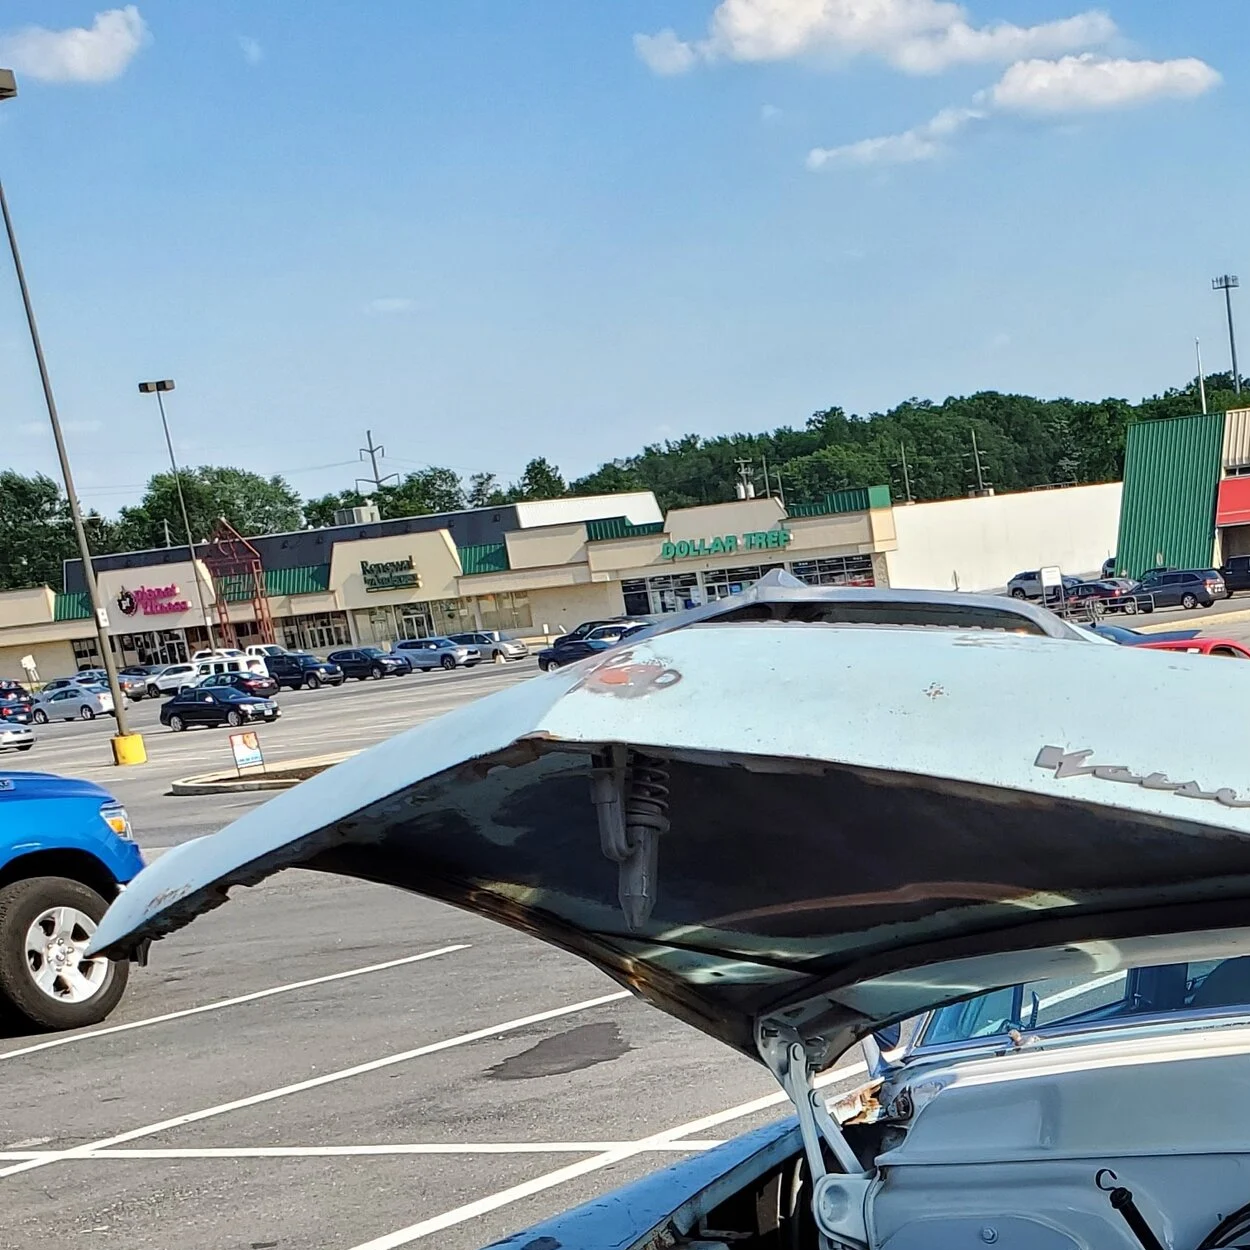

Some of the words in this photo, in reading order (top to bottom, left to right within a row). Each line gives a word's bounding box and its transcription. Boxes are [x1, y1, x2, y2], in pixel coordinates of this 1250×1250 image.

[662, 535, 738, 559] DOLLAR
[743, 529, 791, 549] TREE
[360, 555, 413, 575] Renewal
